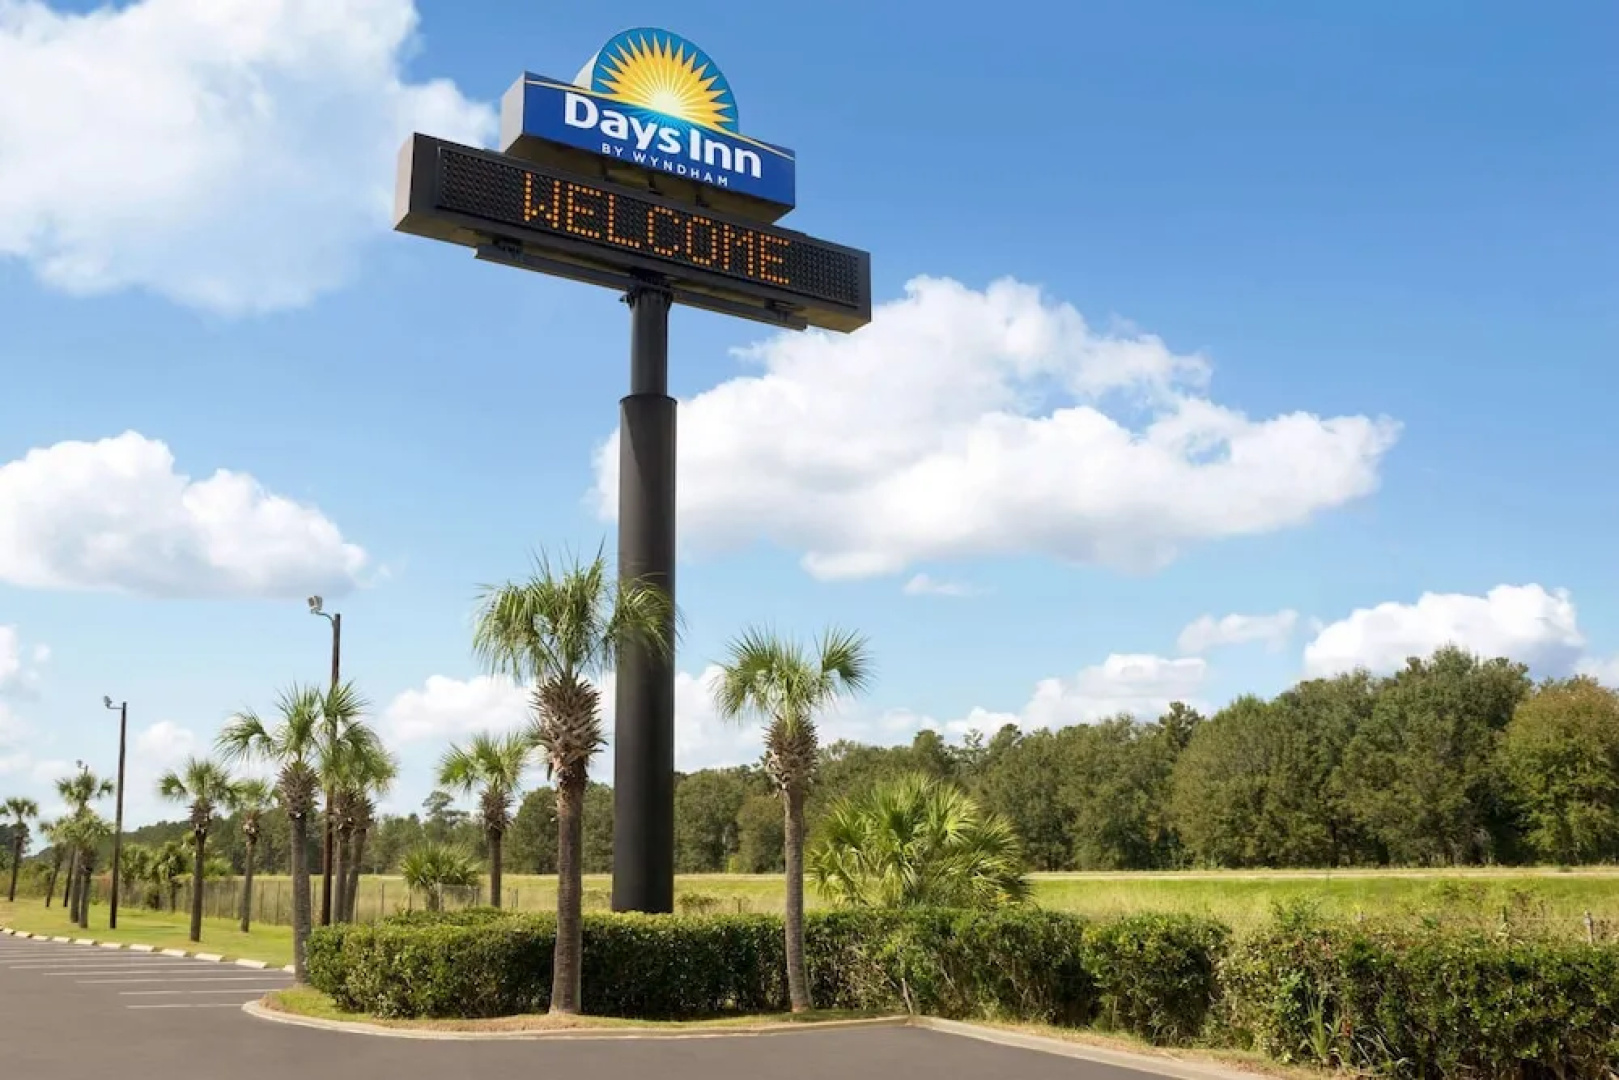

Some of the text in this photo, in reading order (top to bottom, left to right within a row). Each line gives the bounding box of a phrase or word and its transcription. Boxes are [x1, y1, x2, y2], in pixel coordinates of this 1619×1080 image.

[564, 91, 762, 179] Days Inn
[601, 141, 729, 188] BY WYNDHAM
[522, 171, 791, 285] WELCOME
